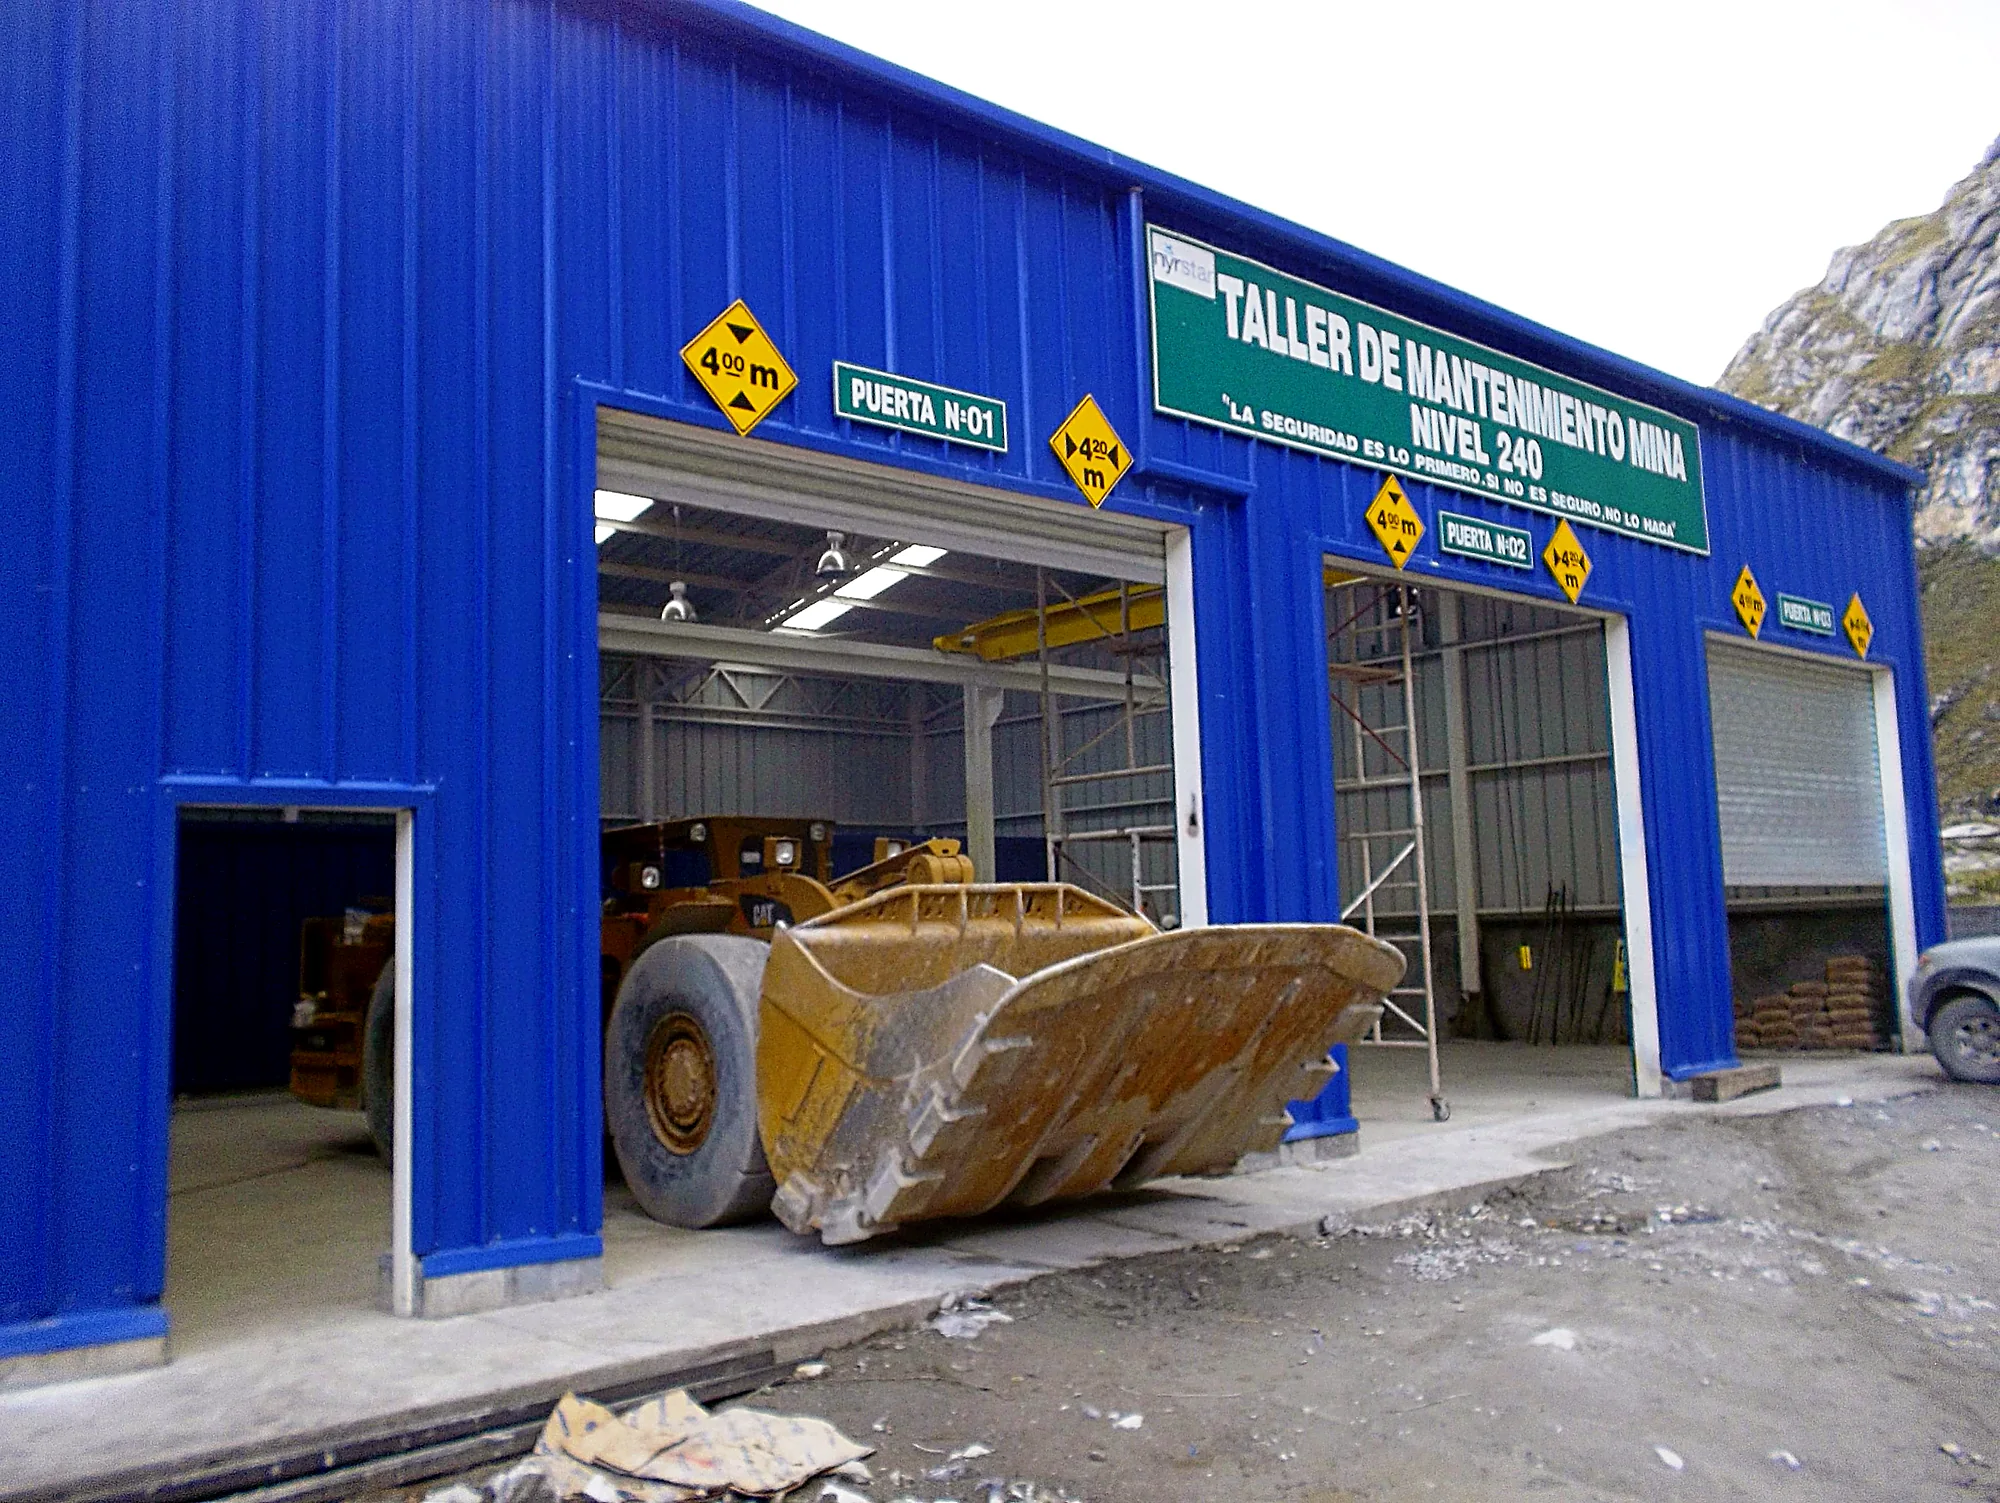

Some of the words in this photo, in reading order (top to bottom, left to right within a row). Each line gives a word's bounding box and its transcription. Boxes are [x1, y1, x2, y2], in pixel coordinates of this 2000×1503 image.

[1155, 251, 1214, 283] nyrstar
[750, 362, 779, 390] m
[1217, 273, 1353, 376] TALLER
[1357, 321, 1403, 391] DE
[1405, 339, 1625, 462] MANTENIMIENTO
[1628, 416, 1687, 482] MINA
[852, 377, 936, 426] PUERTA
[1410, 402, 1490, 466] NIVEL
[1496, 430, 1543, 480] 240
[1083, 467, 1105, 489] m
[1261, 410, 1358, 452] SEGURIDAD
[1363, 438, 1385, 459] ES
[1388, 445, 1410, 465] LO
[1415, 454, 1480, 484] PRIMERO
[1504, 478, 1524, 497] NO
[1529, 485, 1547, 503] ES
[1624, 511, 1640, 529] LO
[1401, 518, 1416, 537] m
[1447, 521, 1493, 553] PUERTA
[1783, 600, 1812, 624] PUERTA
[753, 903, 774, 926] CAT
